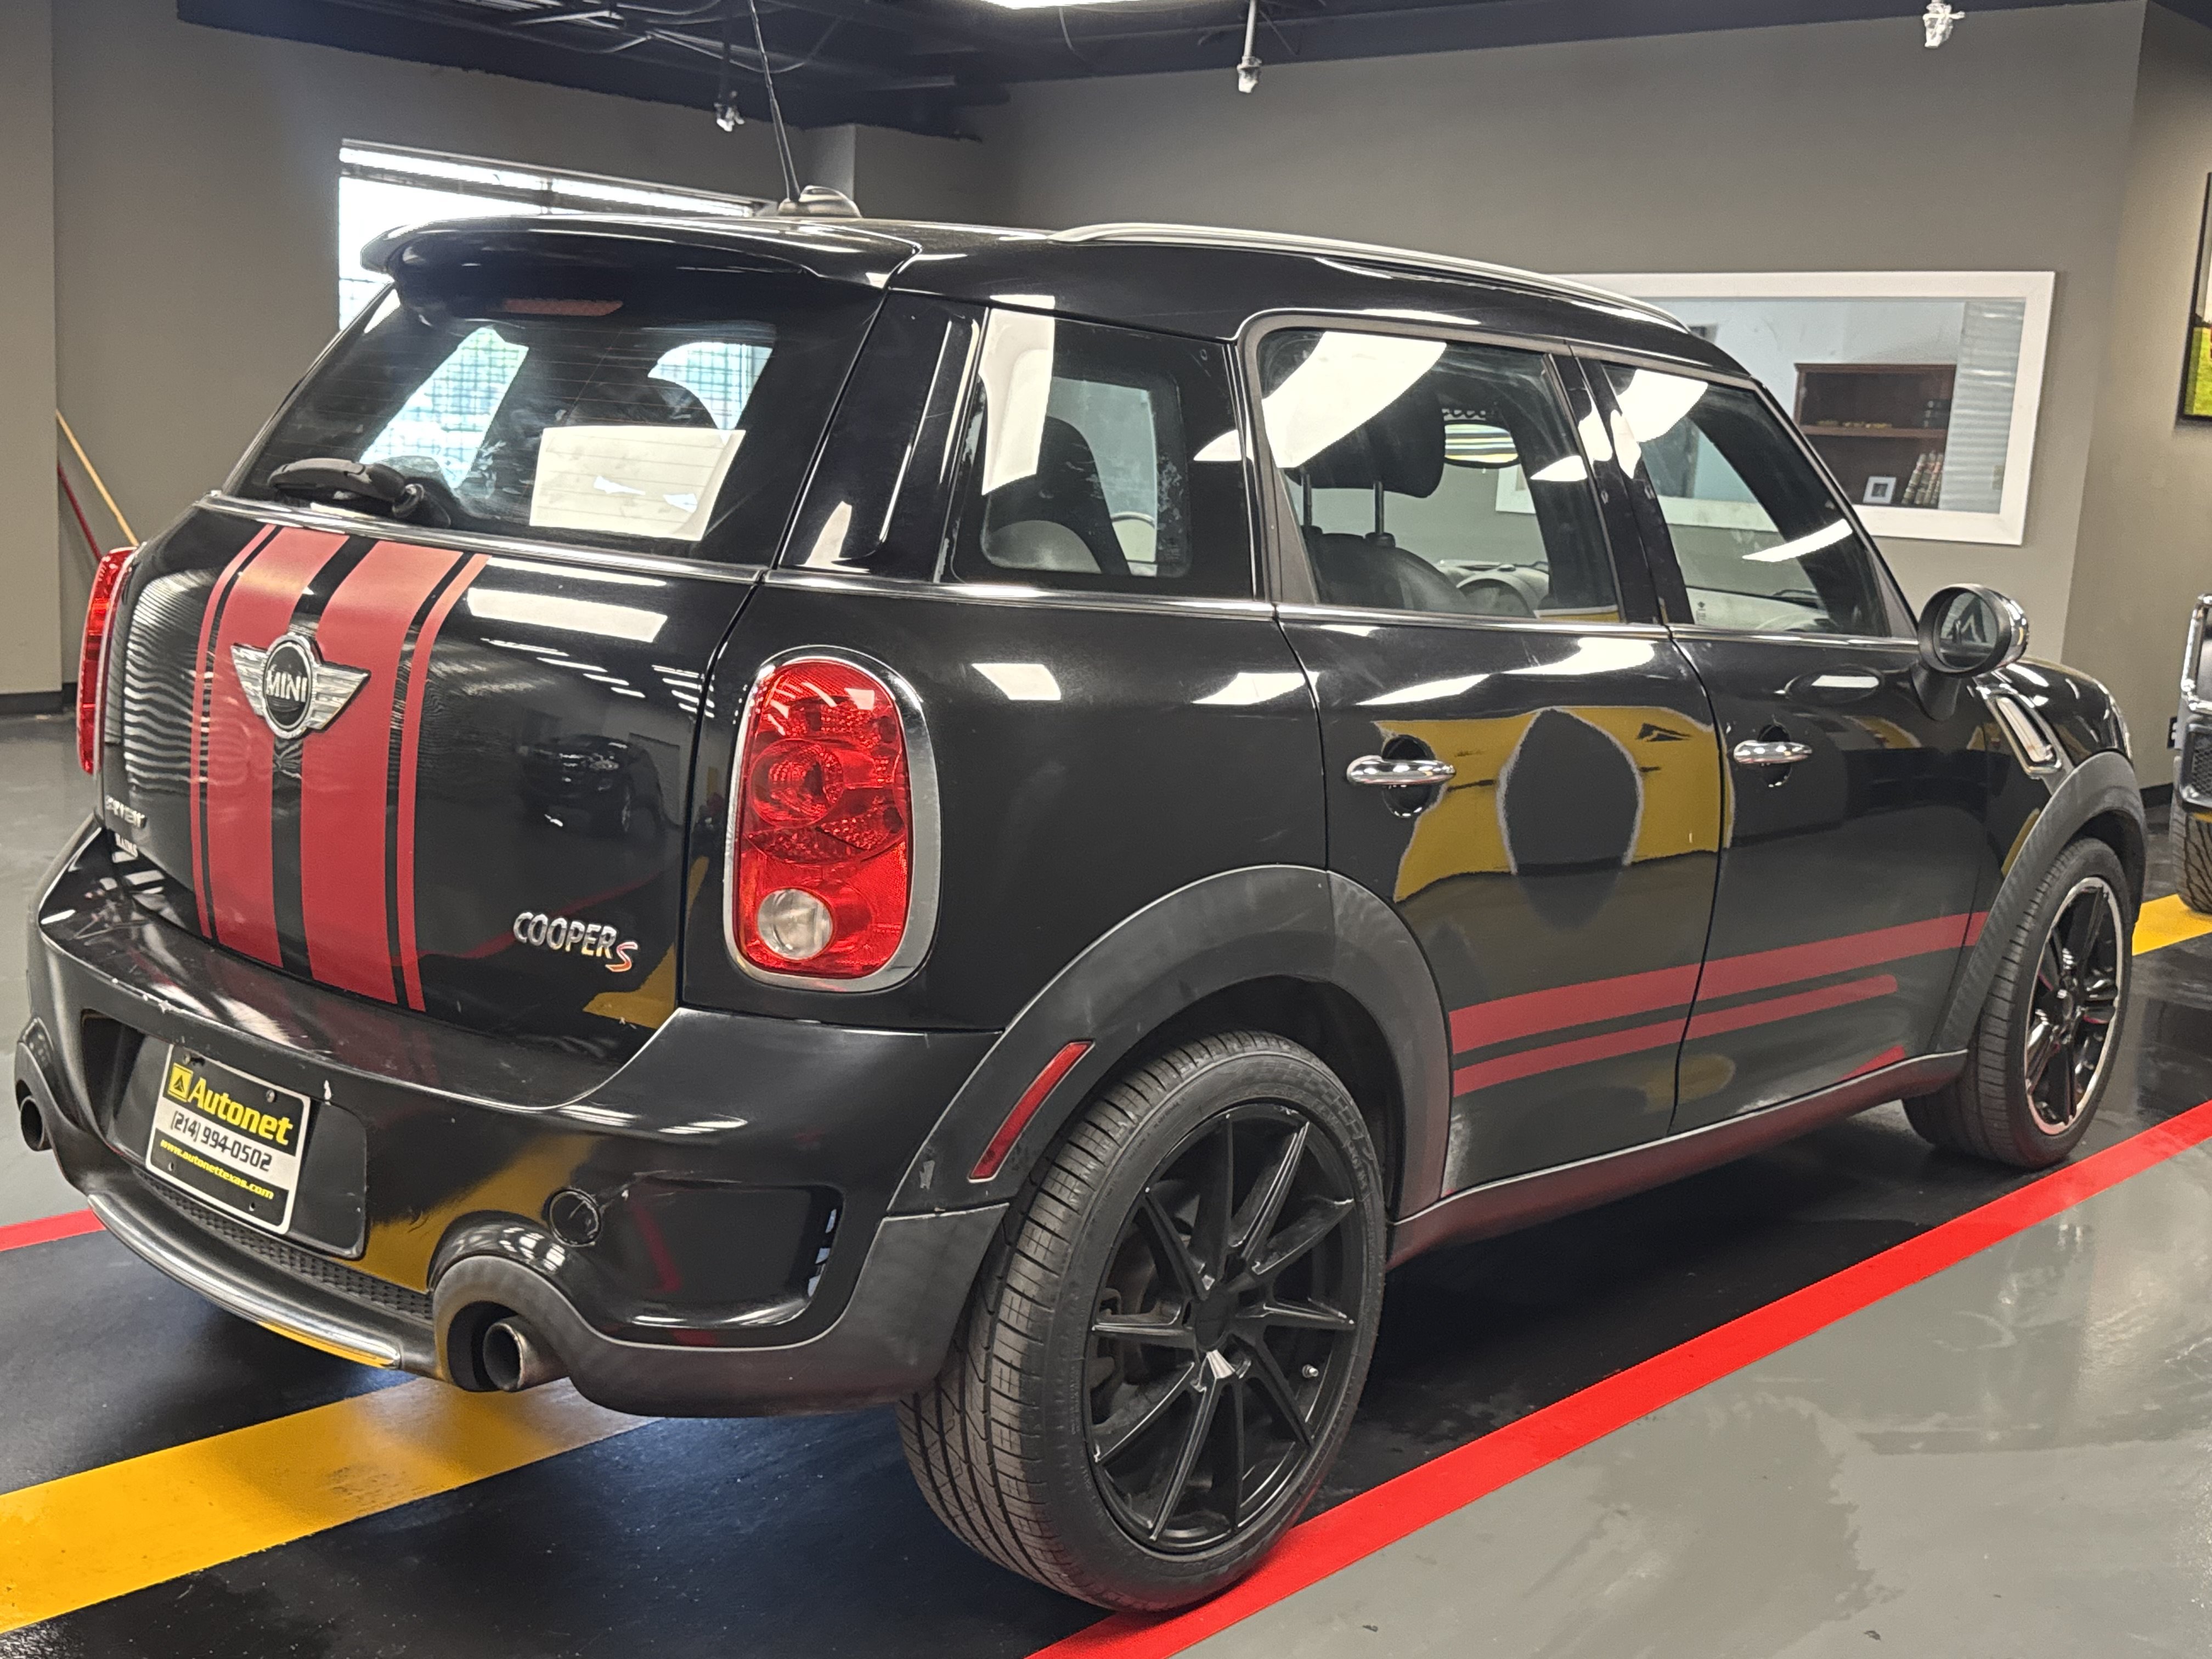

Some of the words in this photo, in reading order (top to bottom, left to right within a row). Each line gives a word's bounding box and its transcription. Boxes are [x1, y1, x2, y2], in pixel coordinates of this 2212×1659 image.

[266, 670, 308, 702] MINI
[512, 911, 618, 959] COOPER
[605, 941, 638, 973] S
[170, 1110, 200, 1142] (214)
[201, 1127, 273, 1172] 994-0502
[187, 1077, 293, 1146] Autonet
[160, 1139, 274, 1200] www.autonettexas.com
